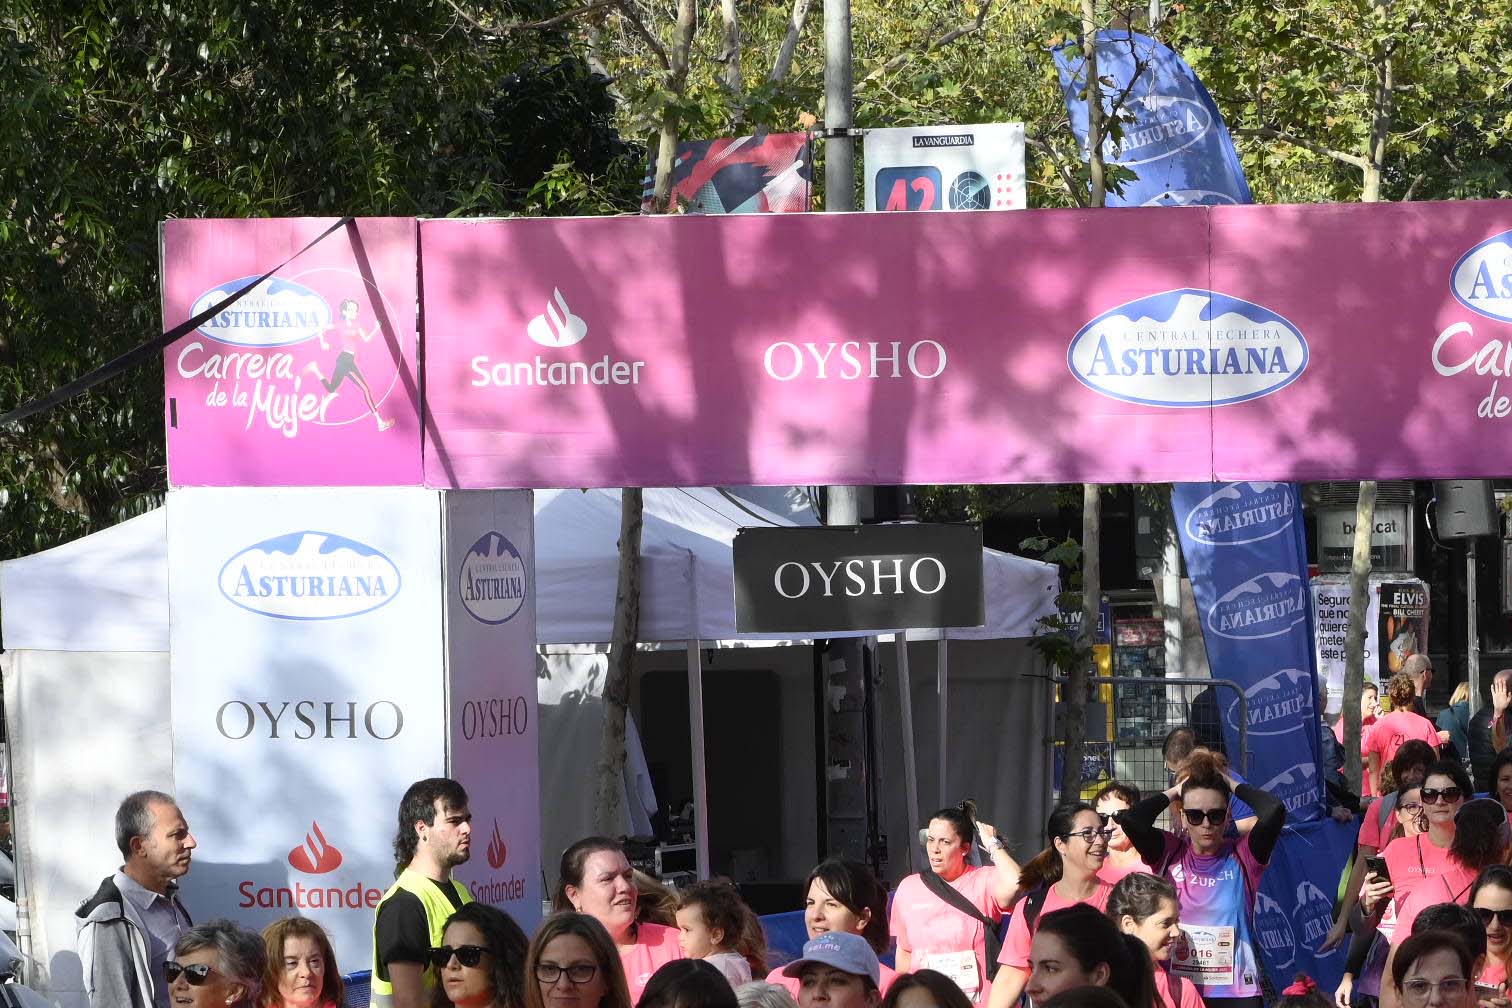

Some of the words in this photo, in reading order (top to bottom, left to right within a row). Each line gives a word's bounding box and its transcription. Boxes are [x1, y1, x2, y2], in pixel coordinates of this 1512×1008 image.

[924, 136, 973, 146] VANGUARDIA
[1123, 328, 1200, 343] CENTRAL
[1207, 326, 1281, 341] LECHERA
[177, 342, 294, 380] Carrera
[471, 355, 645, 387] Santander
[763, 339, 948, 381] OYSHO
[1085, 333, 1290, 378] ASTURIANA
[206, 384, 230, 407] de
[232, 381, 249, 405] la
[245, 376, 339, 439] Mujer
[1477, 381, 1511, 419] de
[232, 564, 388, 598] ASTURIANA
[464, 565, 523, 601] ASTURIANA
[774, 557, 947, 599] OYSHO
[1319, 609, 1335, 621] que
[1393, 592, 1424, 605] ELVIS
[1320, 621, 1351, 634] quiere
[216, 700, 404, 740] OYSHO
[462, 696, 527, 741] OYSHO
[469, 875, 526, 902] Santander
[1190, 869, 1234, 888] ZURCH
[1190, 949, 1212, 958] 016
